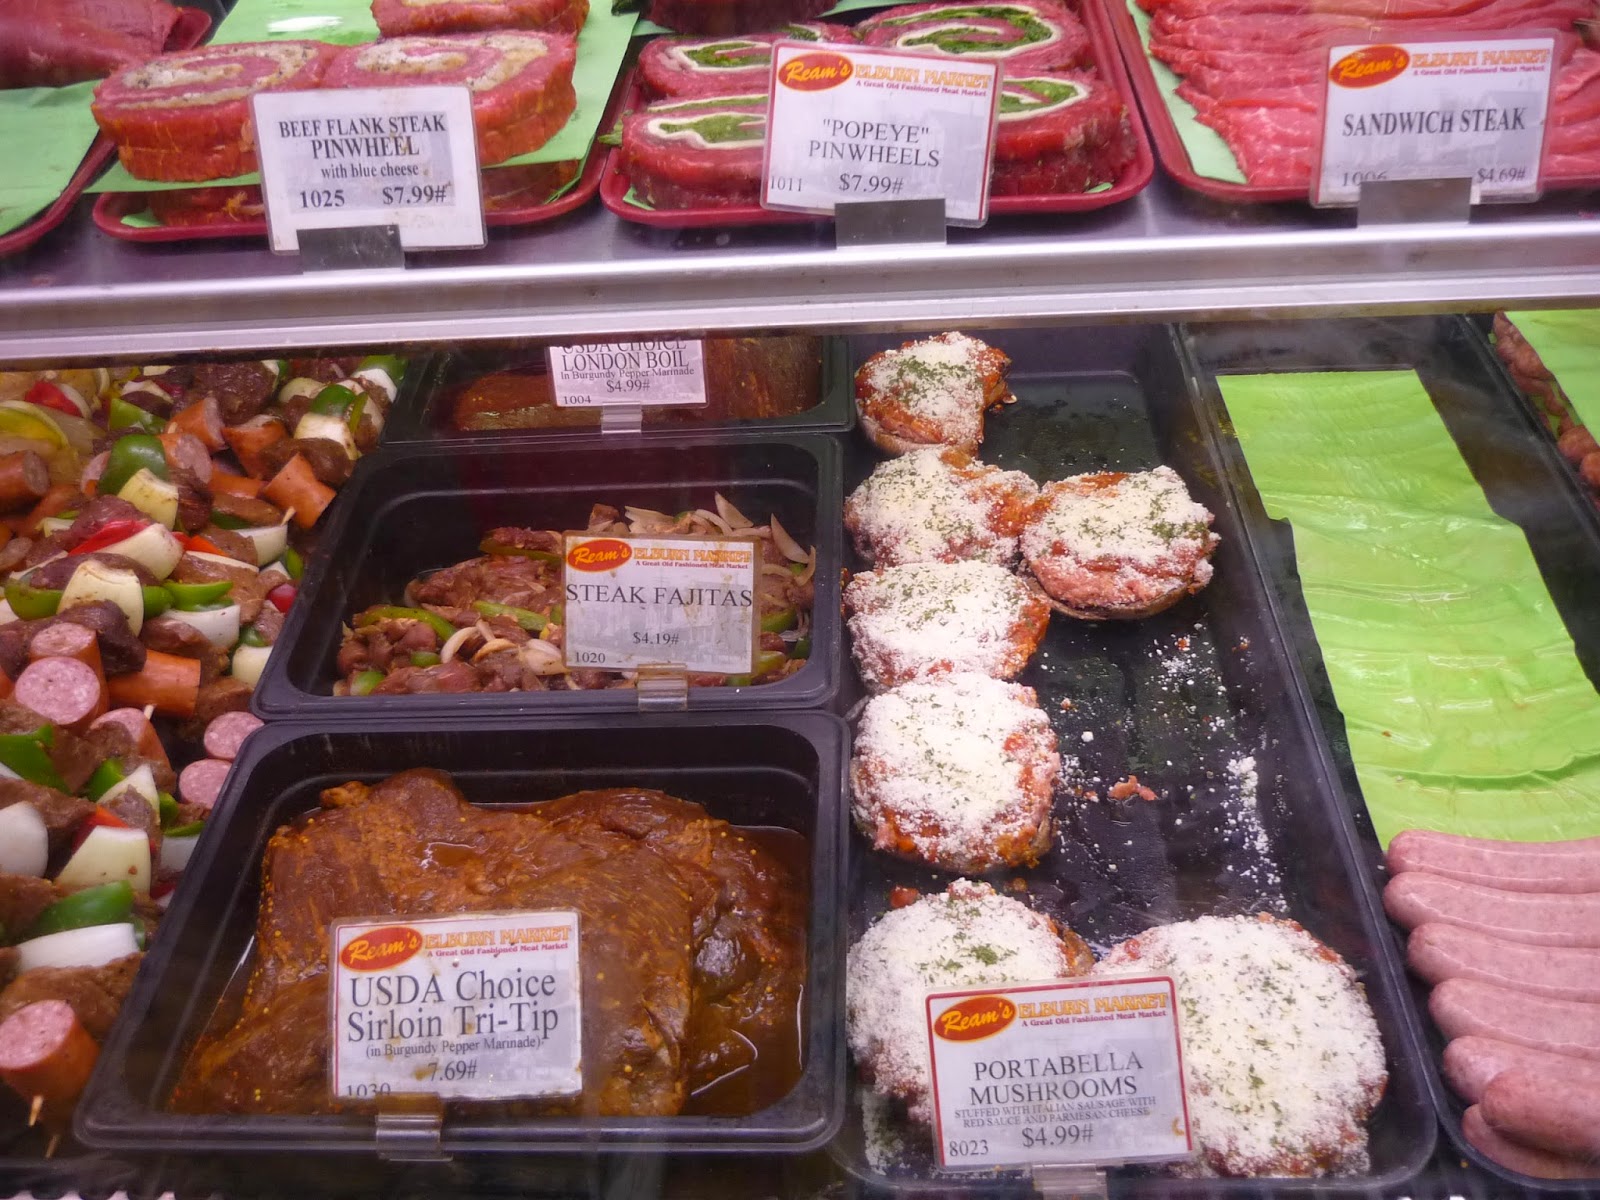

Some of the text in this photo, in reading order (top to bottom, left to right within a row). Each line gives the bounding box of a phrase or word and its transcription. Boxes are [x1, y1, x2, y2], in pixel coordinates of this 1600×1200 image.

[786, 60, 850, 82] Ream's
[1339, 52, 1406, 80] Ream's
[279, 114, 446, 138] BEEF FLANK STEAK
[823, 119, 929, 144] "POPEYE"
[1342, 107, 1528, 136] SANDWICH STEAK
[312, 136, 420, 159] PINWHEEL
[808, 140, 940, 168] PINWHEELS
[321, 162, 419, 179] with blue cheese
[1477, 167, 1526, 184] $4.69#
[770, 175, 802, 192] 1011
[839, 173, 904, 194] $7.99#
[300, 189, 345, 208] 1025
[382, 185, 447, 205] $7.99#
[562, 350, 689, 371] LONDON BOIL
[572, 371, 615, 380] Burgundy
[620, 370, 649, 378] Pepper
[652, 367, 694, 376] Marinade
[607, 379, 650, 393] $4.99#
[563, 395, 591, 405] 1004
[573, 545, 630, 565] Ream's
[566, 584, 752, 607] STEAK FAJITAS
[633, 632, 679, 645] $4.19#
[575, 652, 606, 664] 1020
[350, 932, 418, 963] Ream's
[425, 925, 571, 949] ELBURN MARKET
[351, 967, 556, 1008] USDA Choice
[1019, 993, 1168, 1018] ELBURN MARKET
[348, 1001, 558, 1042] Sirloin Tri-Tip
[941, 1002, 1013, 1035] Ream's
[1072, 1014, 1114, 1023] Fashioned
[366, 1045, 381, 1059] (in
[384, 1042, 436, 1057] Burgundy
[442, 1040, 479, 1055] Pepper
[428, 1059, 478, 1082] 7.69#
[974, 1051, 1144, 1081] PORTABELLA
[970, 1075, 1138, 1106] MUSHROOMS
[955, 1096, 1156, 1118] STUFFED WITH ITALIAN SAUSAGE WITH
[964, 1107, 1150, 1128] RED SAUCE AND PARMESAN CHEESE
[1022, 1123, 1094, 1148] $4.99#
[950, 1140, 989, 1157] 8023
